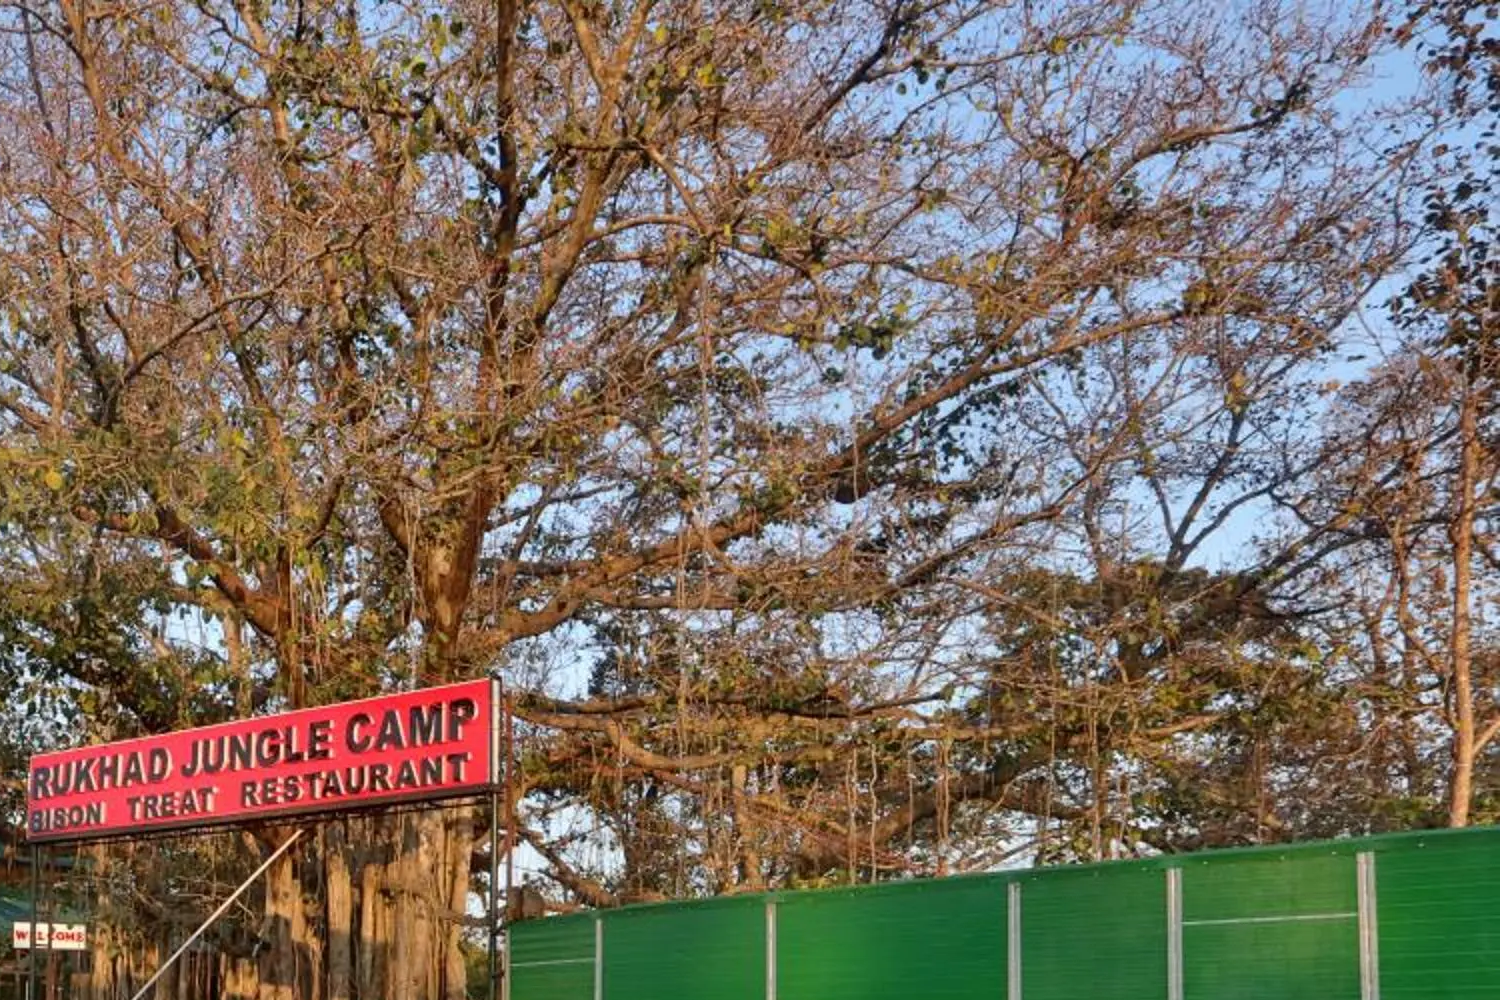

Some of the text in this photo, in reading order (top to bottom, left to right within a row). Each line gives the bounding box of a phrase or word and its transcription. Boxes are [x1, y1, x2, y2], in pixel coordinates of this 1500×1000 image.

[32, 697, 479, 800] RUKHAD JUNGLE CAMP
[31, 751, 473, 833] BISON TREAT RESTAURANT
[15, 930, 85, 942] WLCOME
